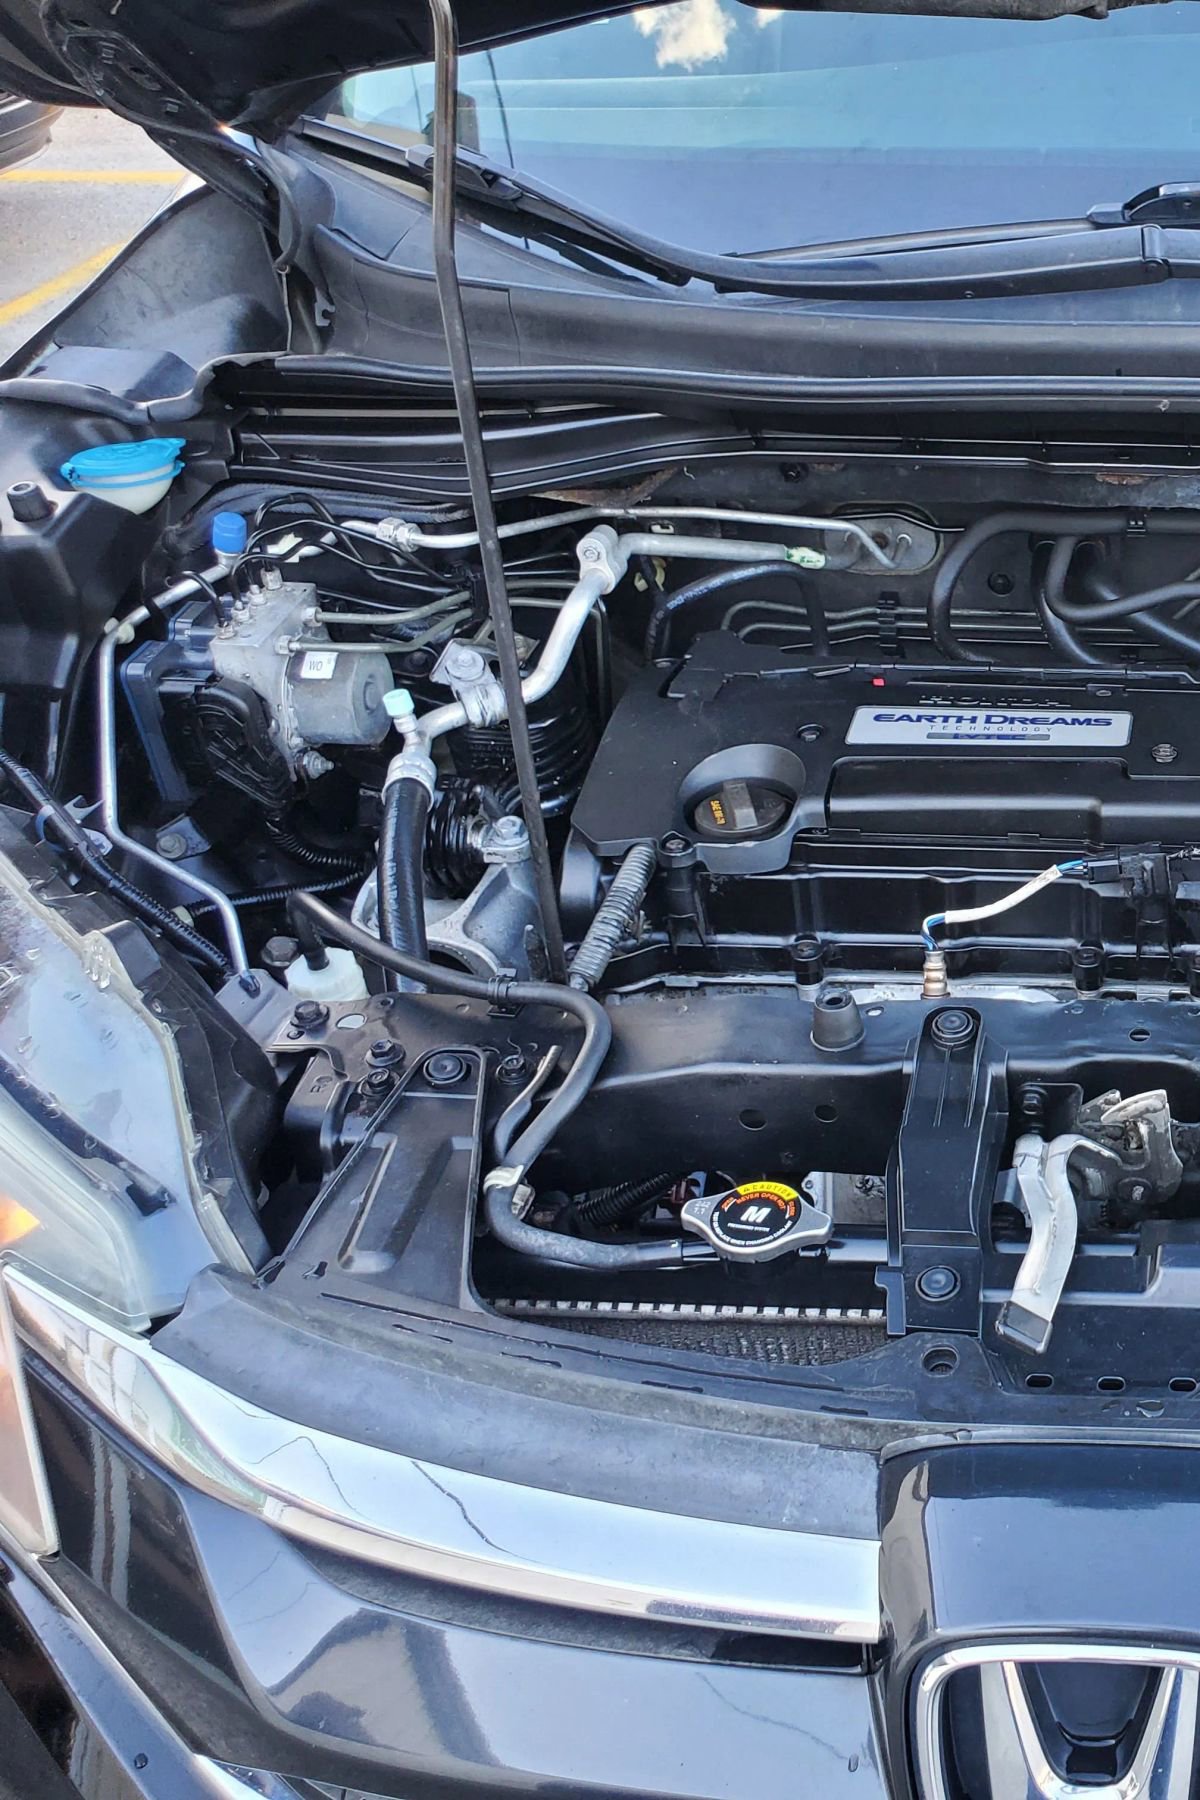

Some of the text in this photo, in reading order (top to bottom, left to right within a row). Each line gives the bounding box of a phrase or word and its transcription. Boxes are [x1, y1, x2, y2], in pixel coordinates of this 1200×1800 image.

[873, 713, 1113, 727] EARTH DREAMS
[929, 724, 1054, 733] TECHNOLOGY
[752, 1183, 792, 1198] CAUTION
[736, 1192, 760, 1205] NEVER
[740, 1206, 772, 1223] M
